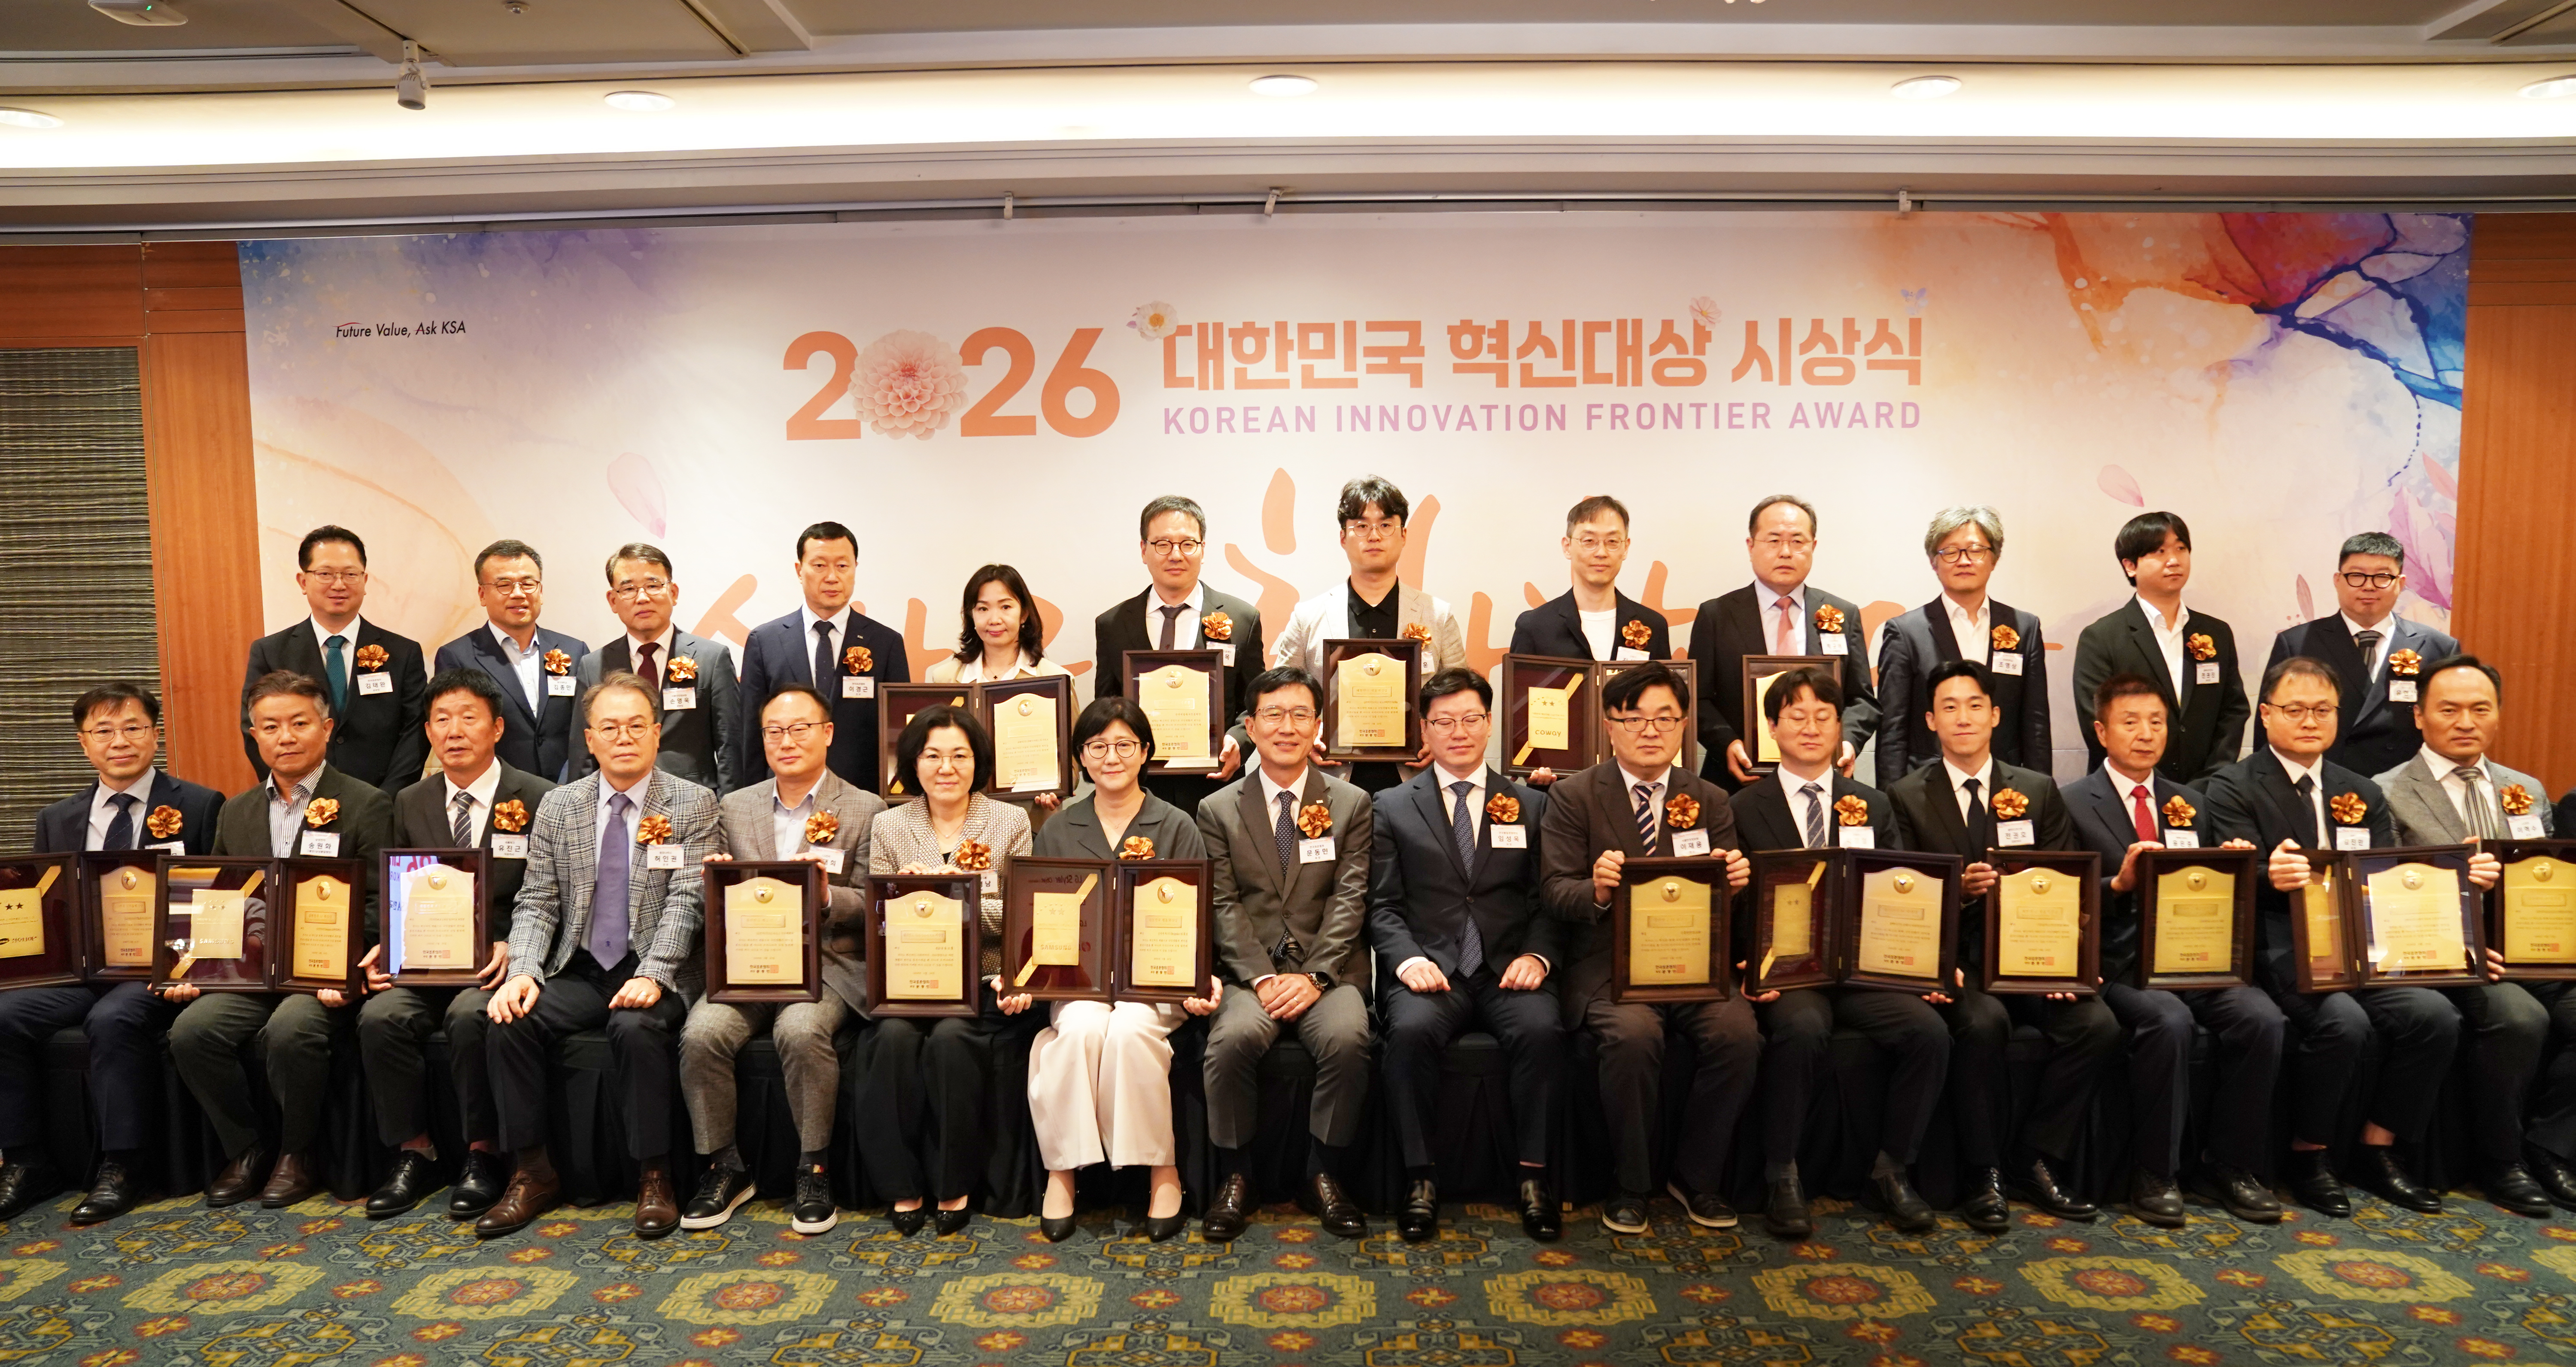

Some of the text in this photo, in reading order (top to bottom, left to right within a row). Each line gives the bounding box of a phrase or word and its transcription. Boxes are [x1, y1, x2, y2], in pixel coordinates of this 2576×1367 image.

[335, 320, 466, 338] Future Value, Ask KSA
[783, 317, 1922, 441] 2026 대한민국 혁신대상 시상식
[1164, 401, 1920, 434] KOREAN INNOVATION FRONTIER AWARD
[1306, 848, 1328, 857] 문동민
